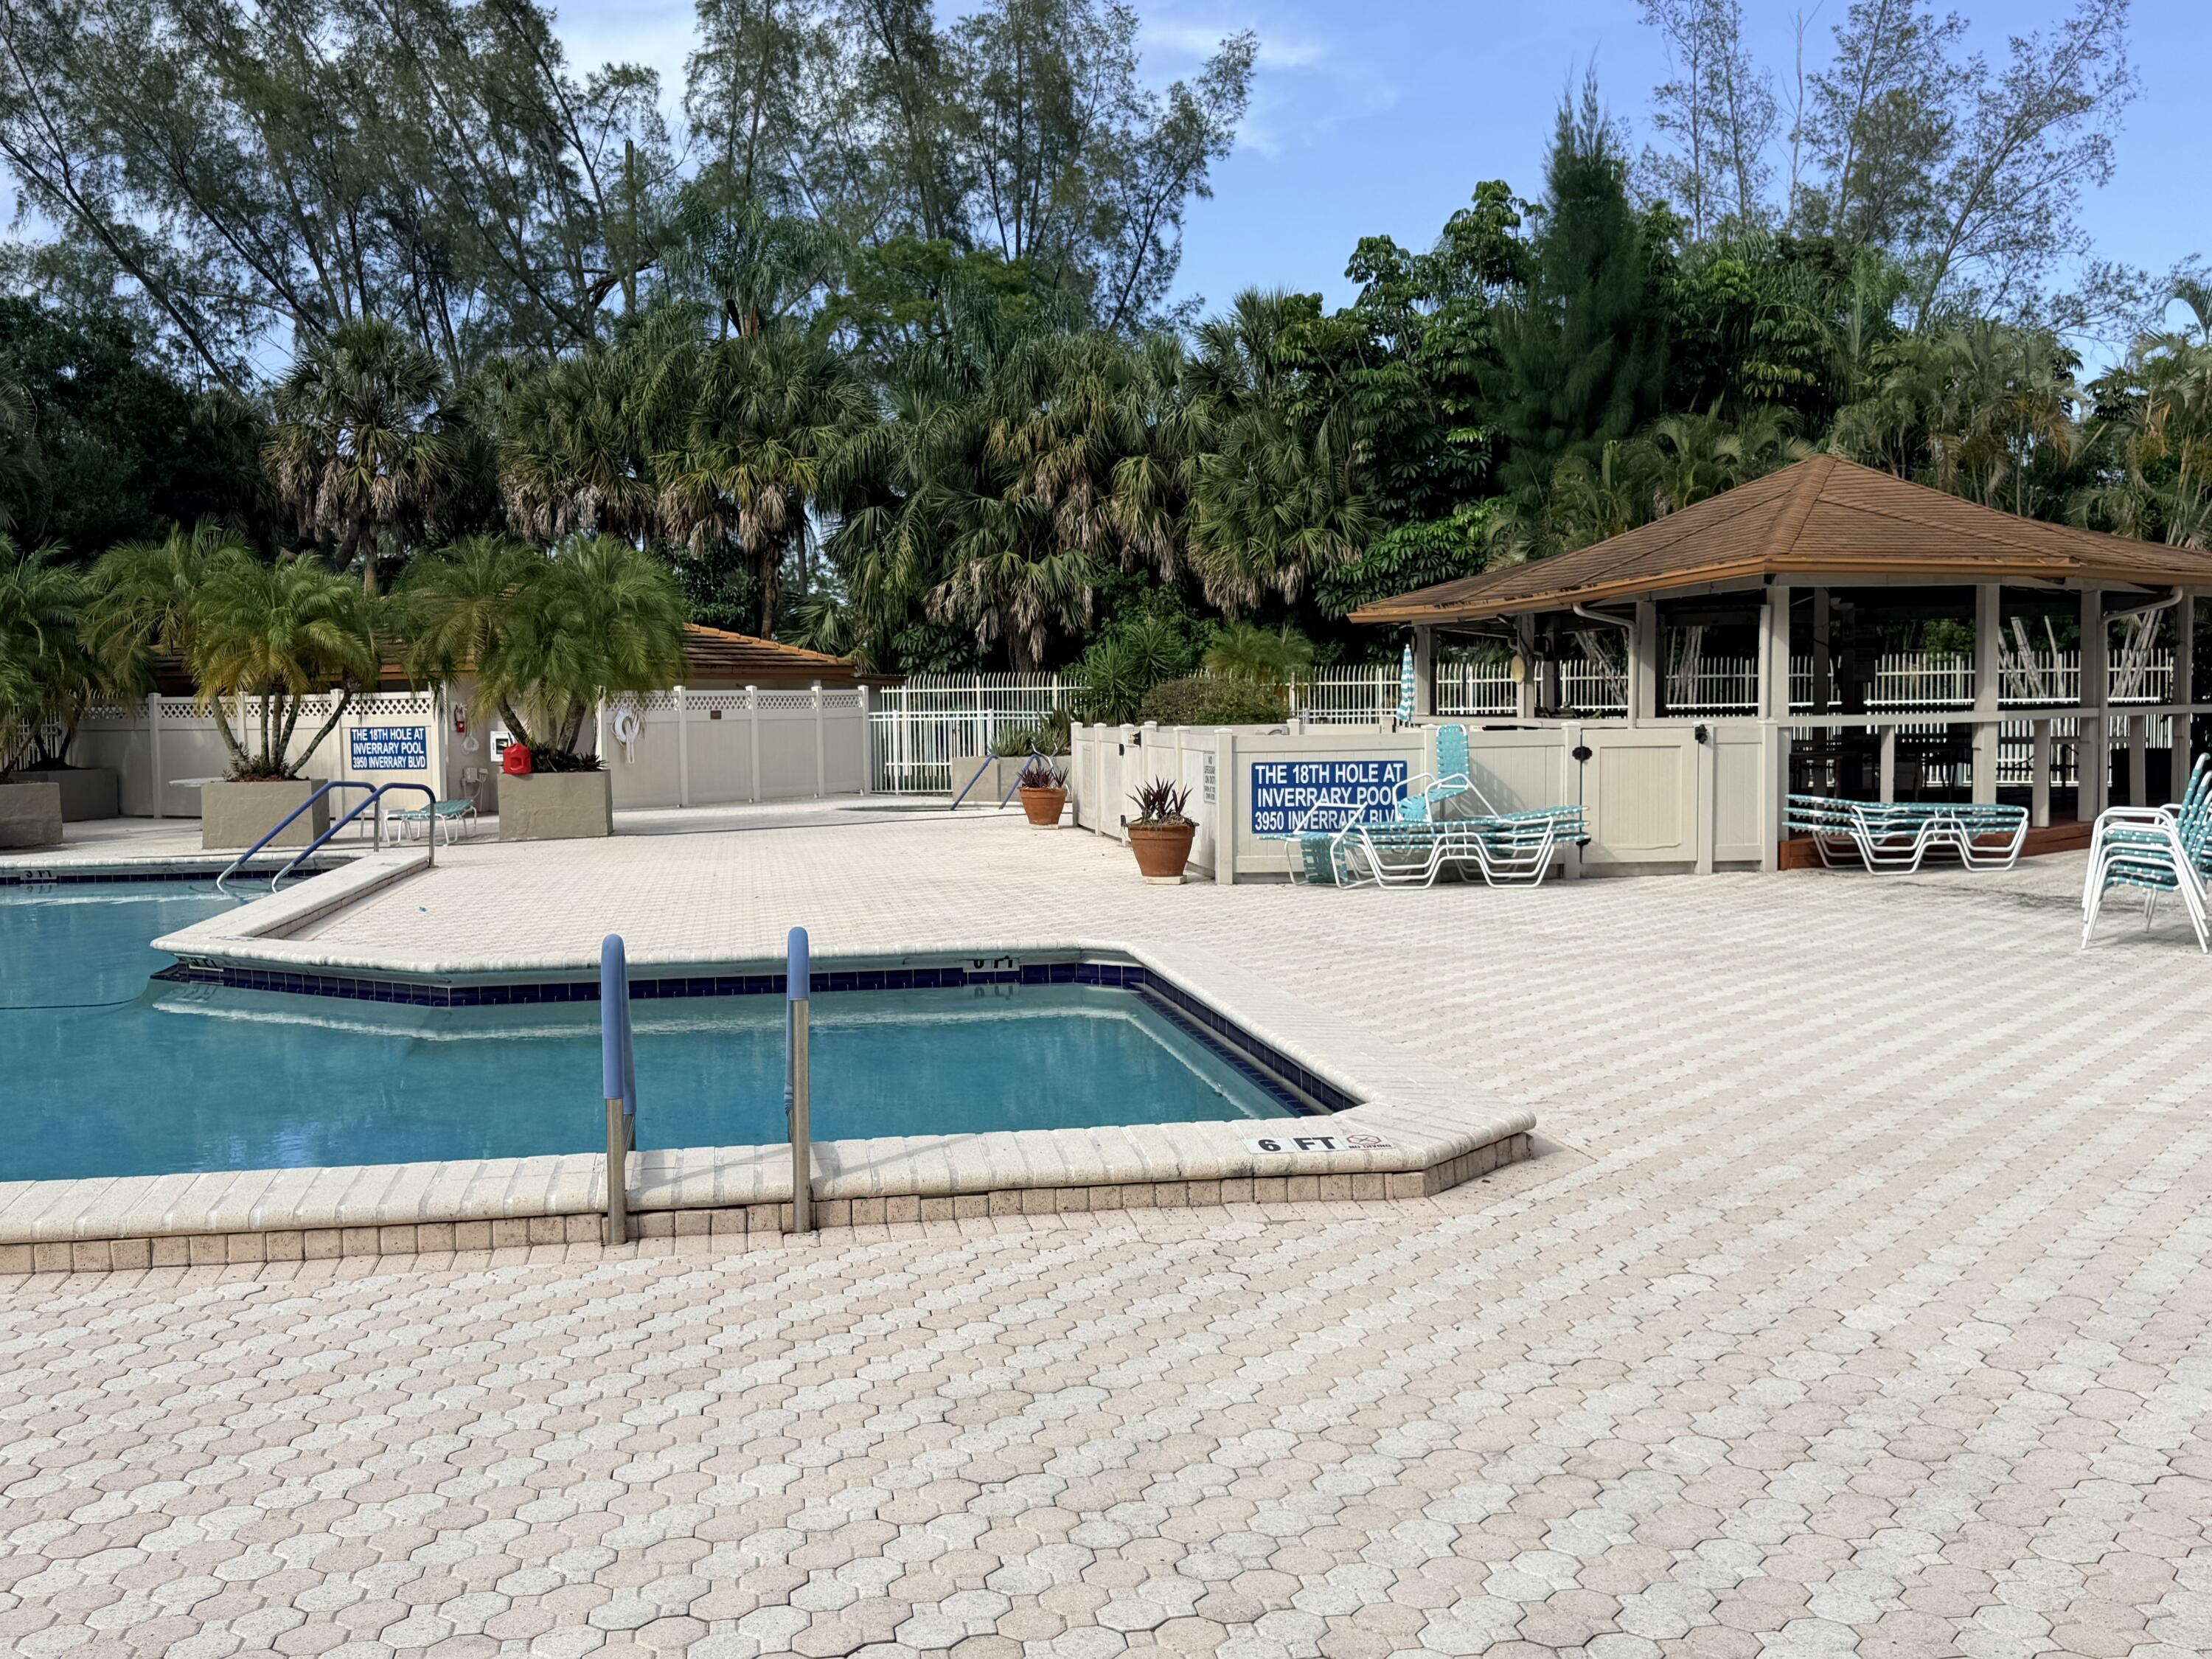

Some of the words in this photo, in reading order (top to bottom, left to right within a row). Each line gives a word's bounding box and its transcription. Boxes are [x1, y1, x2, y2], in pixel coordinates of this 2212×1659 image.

[352, 728, 368, 741] THE
[369, 728, 388, 740] 18TH
[390, 728, 412, 740] HOLE
[414, 728, 424, 740] AT
[354, 742, 399, 754] INVERRARY
[401, 742, 424, 754] POOL
[353, 757, 367, 768] 3950
[369, 756, 406, 768] INVERRARY
[408, 756, 425, 768] BLVD
[1255, 765, 1287, 785] THE
[1293, 764, 1329, 784] 18TH
[1335, 763, 1379, 783] HOLE
[1382, 763, 1404, 782] AT
[1258, 787, 1352, 807] INVERRARY
[1255, 811, 1284, 830] 3950
[1370, 809, 1396, 824] BLV
[1258, 1138, 1281, 1152] 6
[1293, 1136, 1336, 1150] FT
